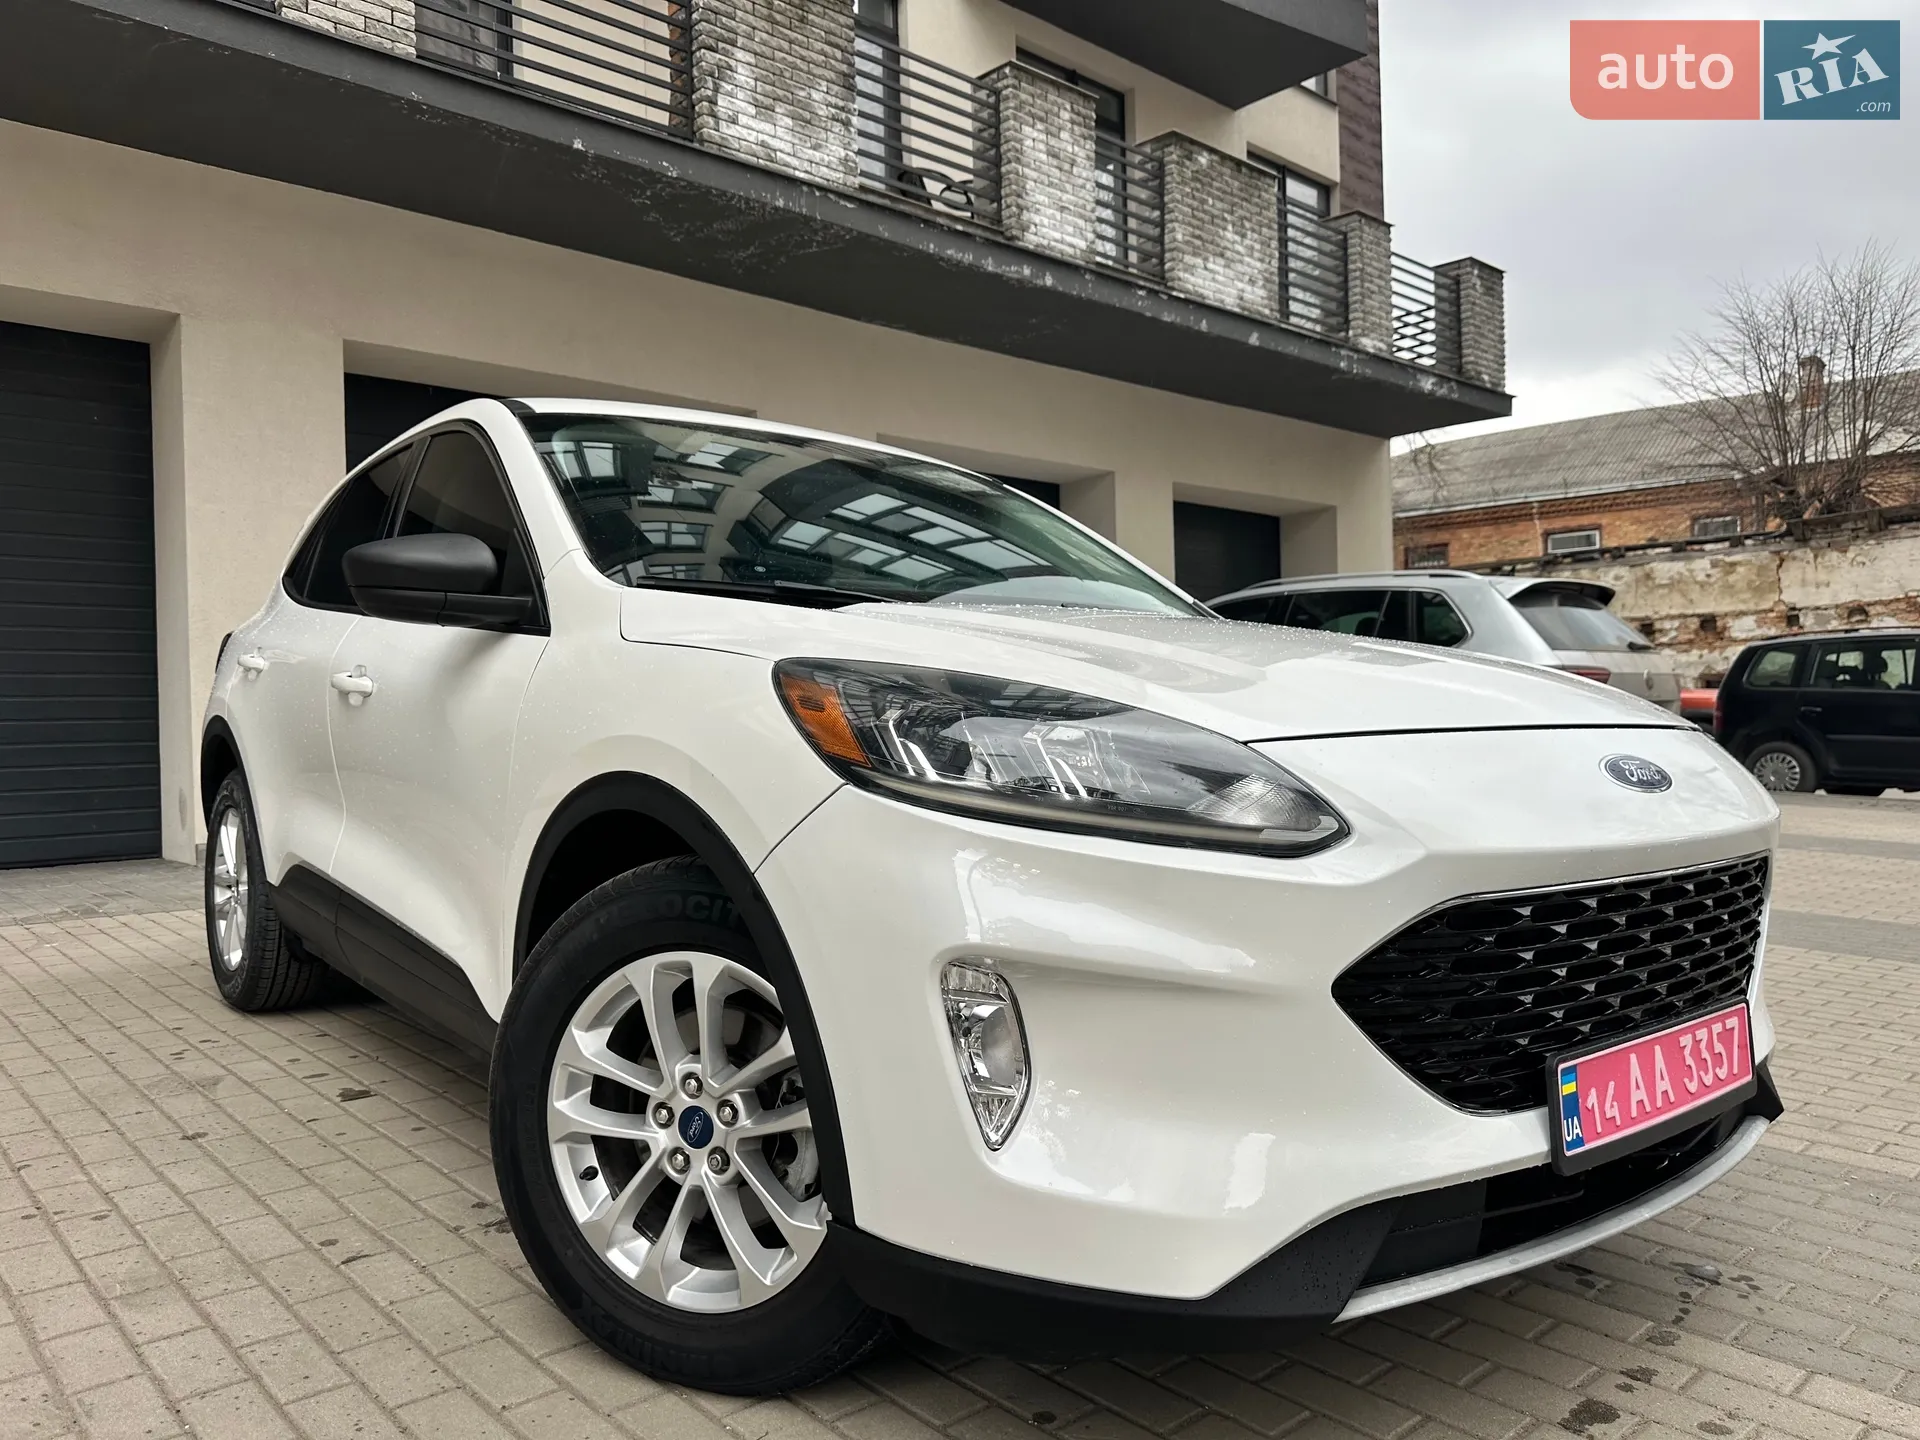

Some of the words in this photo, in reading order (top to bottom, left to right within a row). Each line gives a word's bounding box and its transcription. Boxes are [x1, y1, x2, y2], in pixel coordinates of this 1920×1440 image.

[1619, 760, 1662, 781] Ford
[1585, 1080, 1622, 1134] 14
[1629, 1044, 1675, 1119] AA
[1679, 1016, 1740, 1095] 3357
[1563, 1116, 1583, 1142] UA
